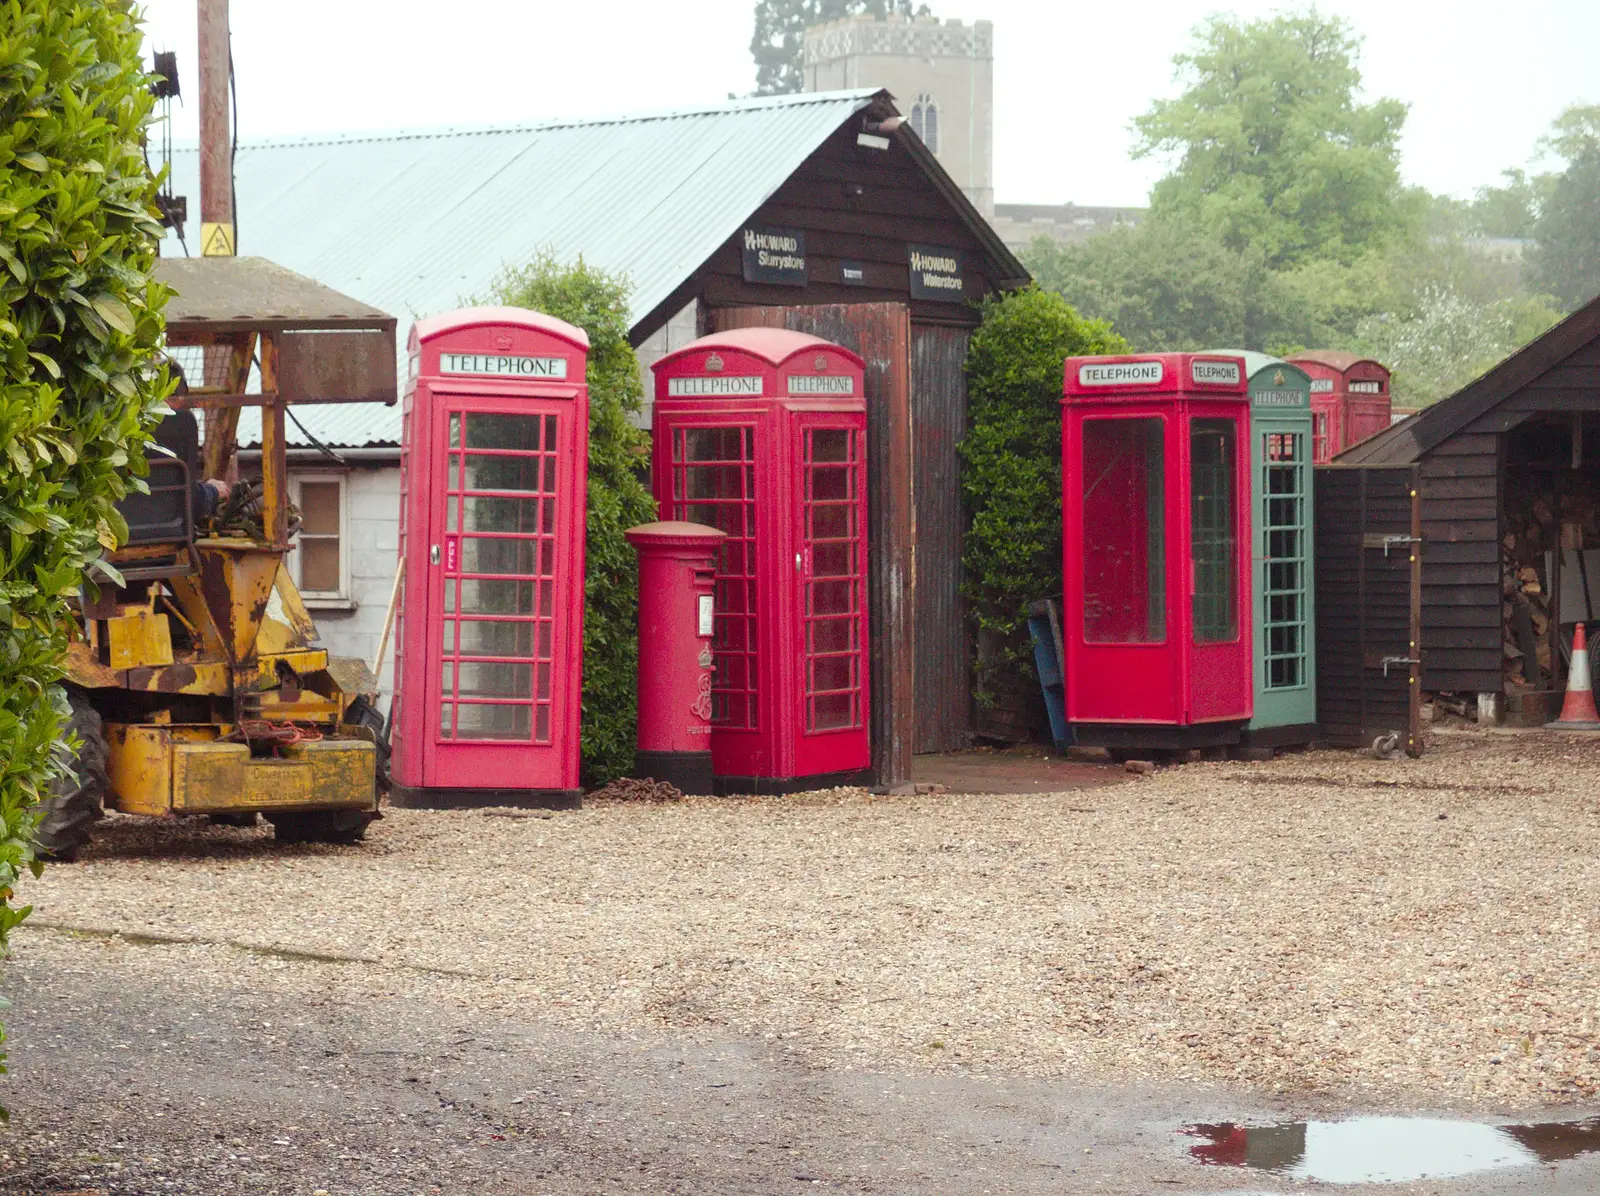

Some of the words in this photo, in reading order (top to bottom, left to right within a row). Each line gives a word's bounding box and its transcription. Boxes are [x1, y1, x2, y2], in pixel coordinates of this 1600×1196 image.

[756, 233, 797, 252] HOWARD
[758, 250, 805, 270] Slurrystore
[921, 255, 957, 273] HOWARD
[922, 273, 963, 291] Waterstore
[448, 355, 558, 375] TELEPHONE
[1085, 367, 1158, 380] TELEPHONE
[1194, 366, 1237, 379] TELEPHONE
[675, 377, 760, 394] TELEPHONE
[790, 376, 850, 393] TELEPHONE
